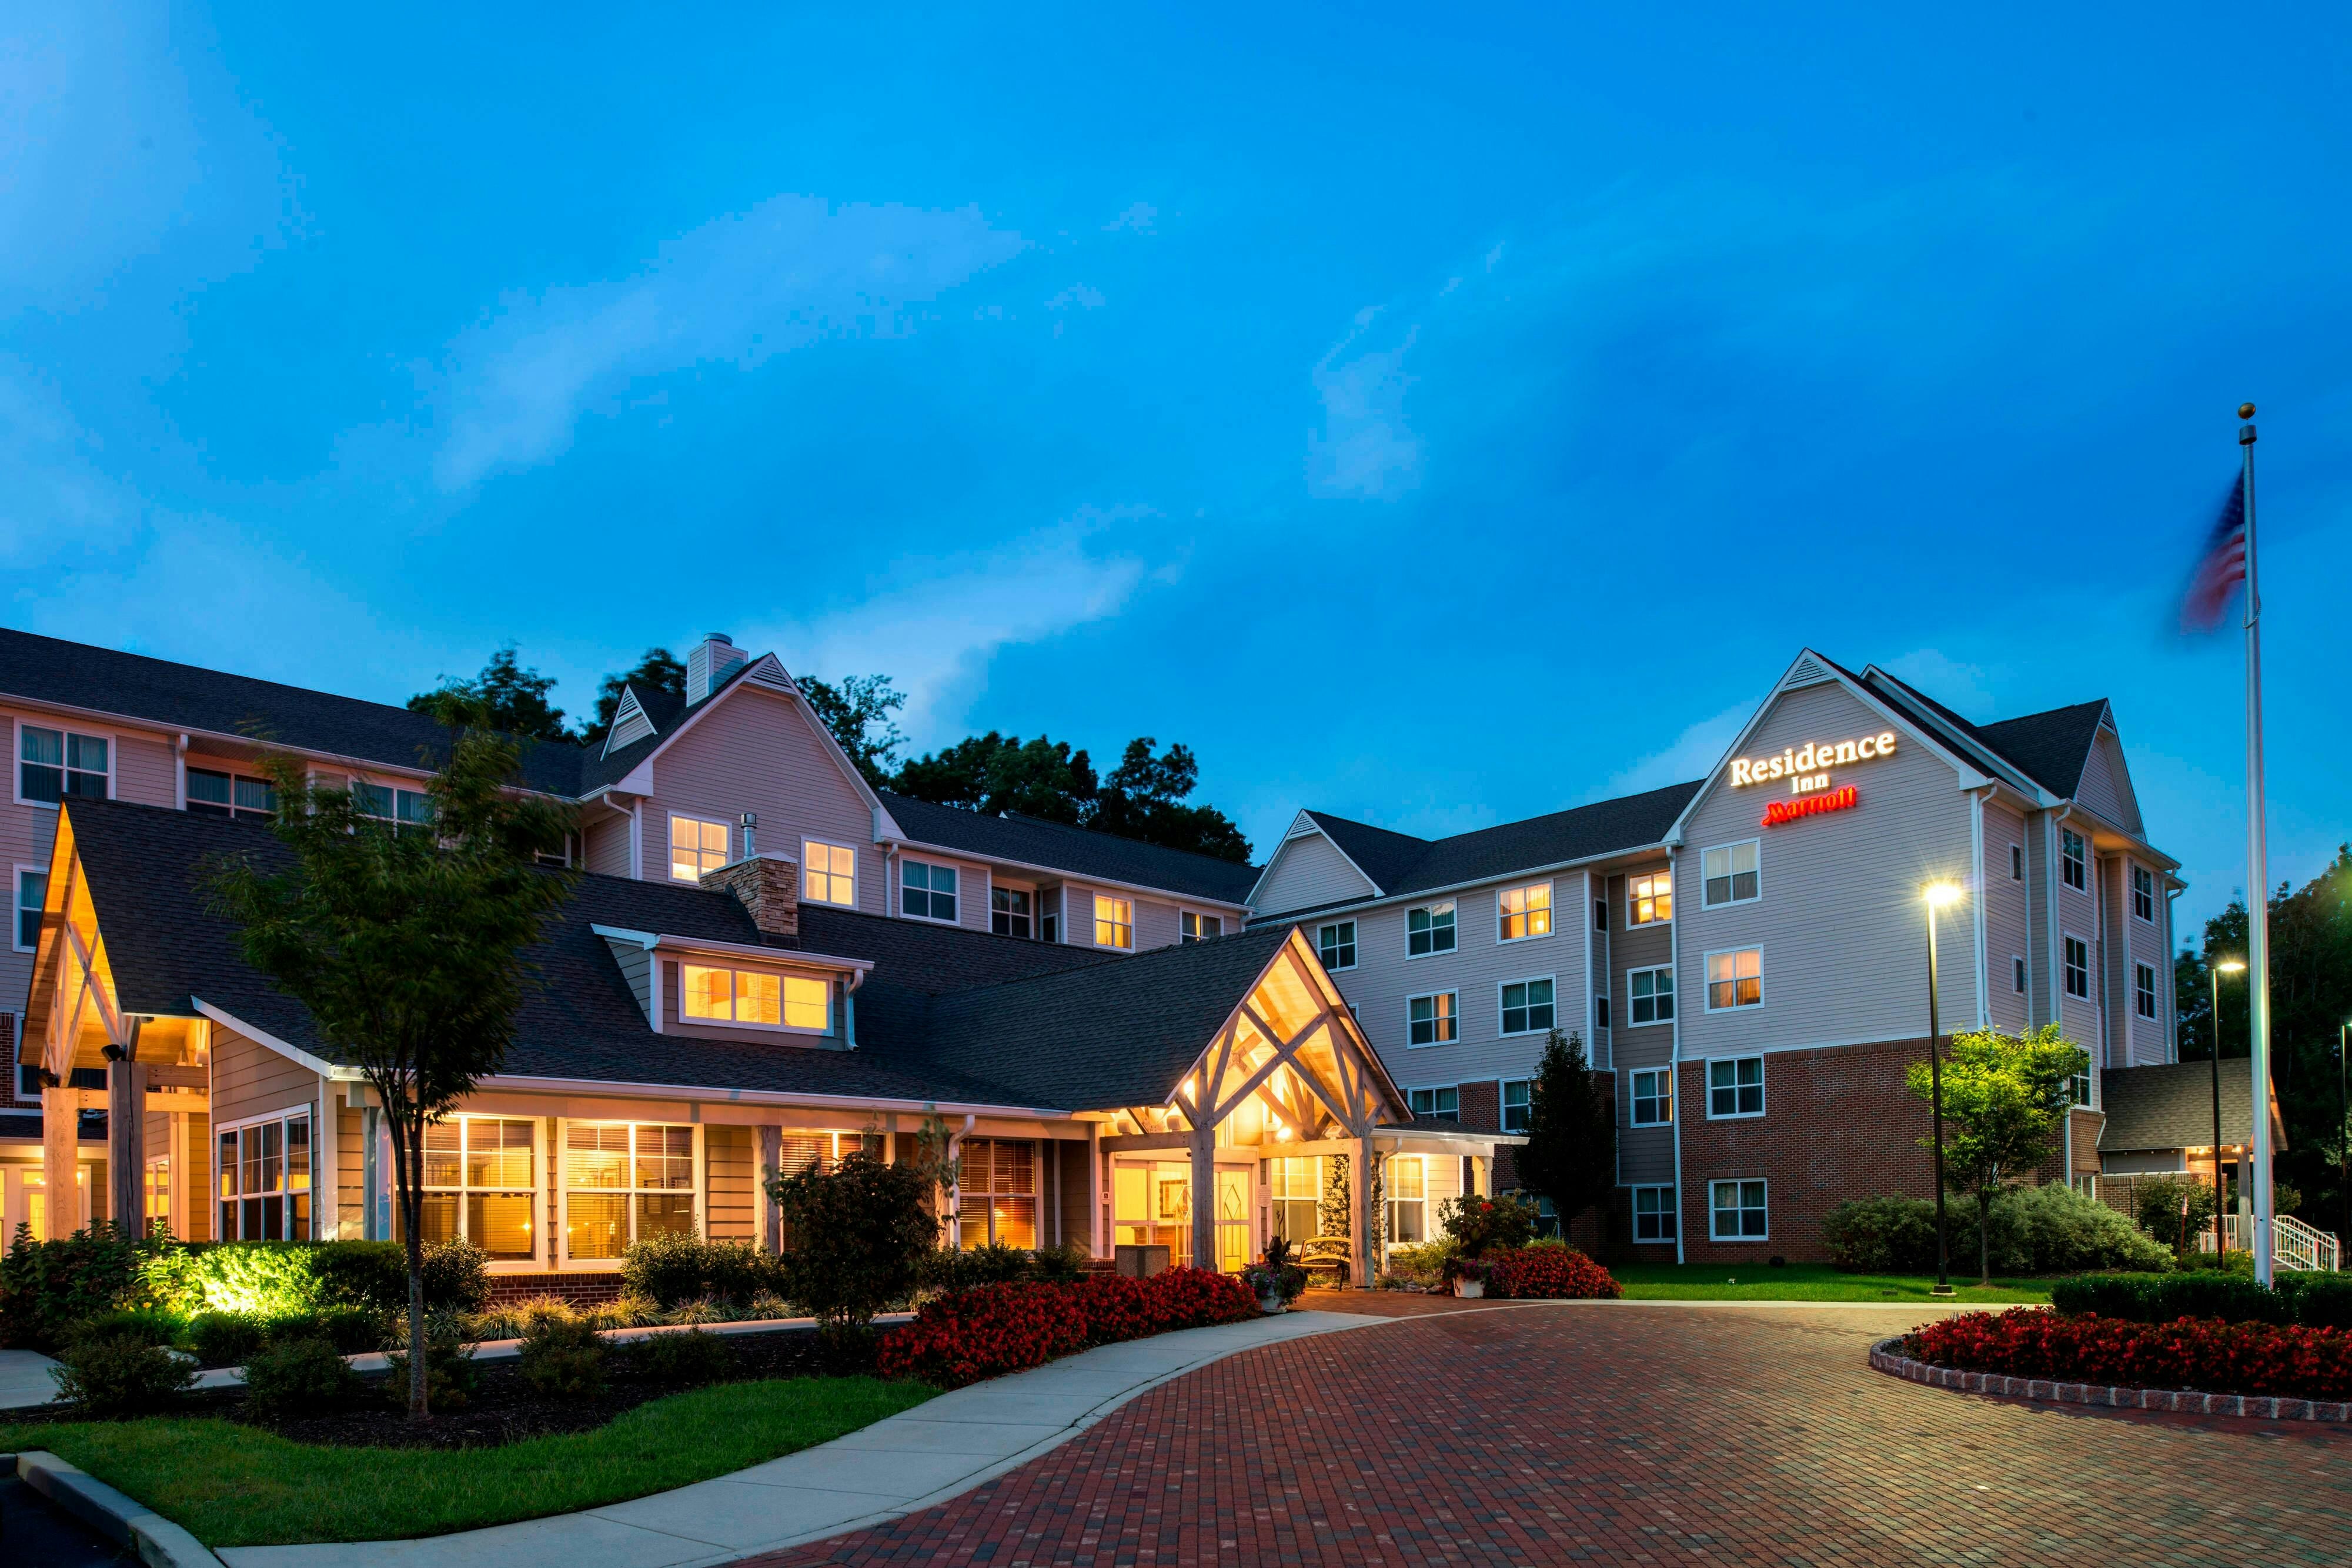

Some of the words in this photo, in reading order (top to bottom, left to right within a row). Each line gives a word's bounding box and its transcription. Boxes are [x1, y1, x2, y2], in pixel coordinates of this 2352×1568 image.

[1730, 732, 1896, 787] Residence
[1791, 773, 1830, 794] Inn
[1762, 786, 1856, 826] Marriott
